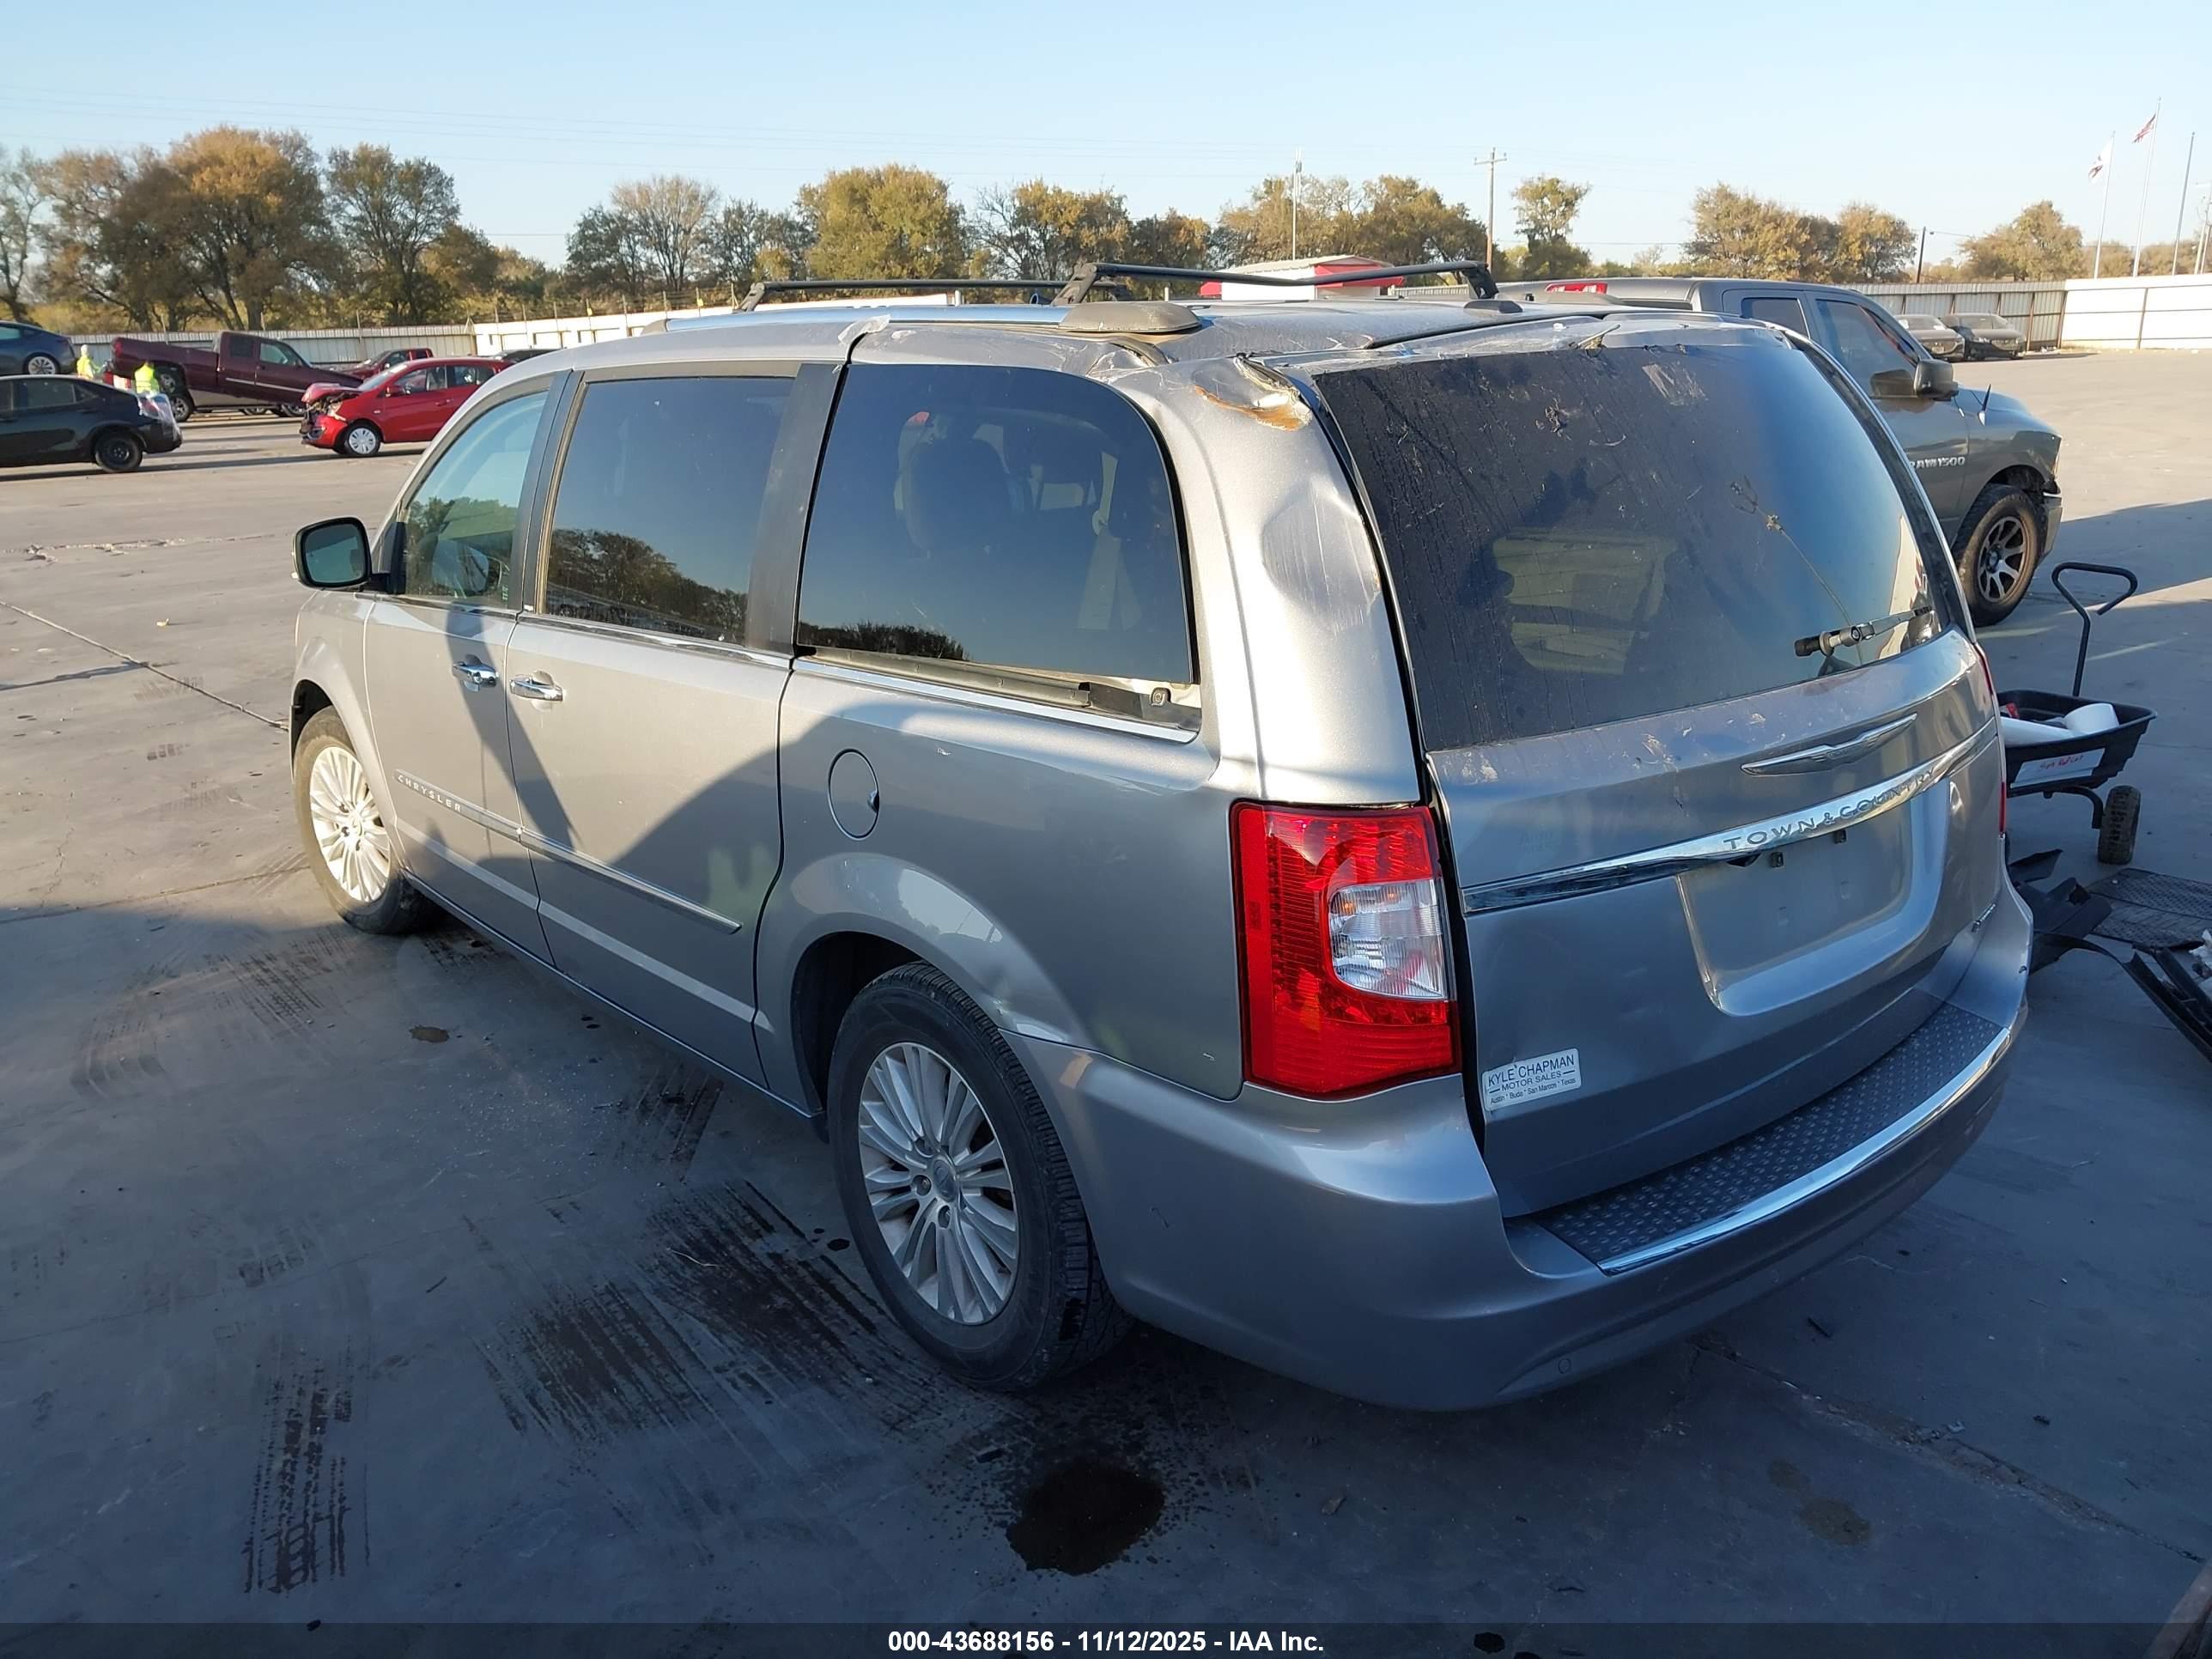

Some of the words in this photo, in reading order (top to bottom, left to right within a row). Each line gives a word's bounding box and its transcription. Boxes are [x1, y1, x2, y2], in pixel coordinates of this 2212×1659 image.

[1937, 456, 1966, 467] 1500
[398, 775, 462, 812] CHRYSLER
[1723, 817, 1815, 849] TOWN
[1488, 1067, 1515, 1087] KYLE
[1518, 1054, 1575, 1079] CHAPMAN
[1501, 1078, 1533, 1091] MOTOR
[1535, 1070, 1562, 1084] SALES
[1527, 1086, 1538, 1095] San
[1538, 1083, 1557, 1092] Marcos
[1561, 1078, 1577, 1086] Texas
